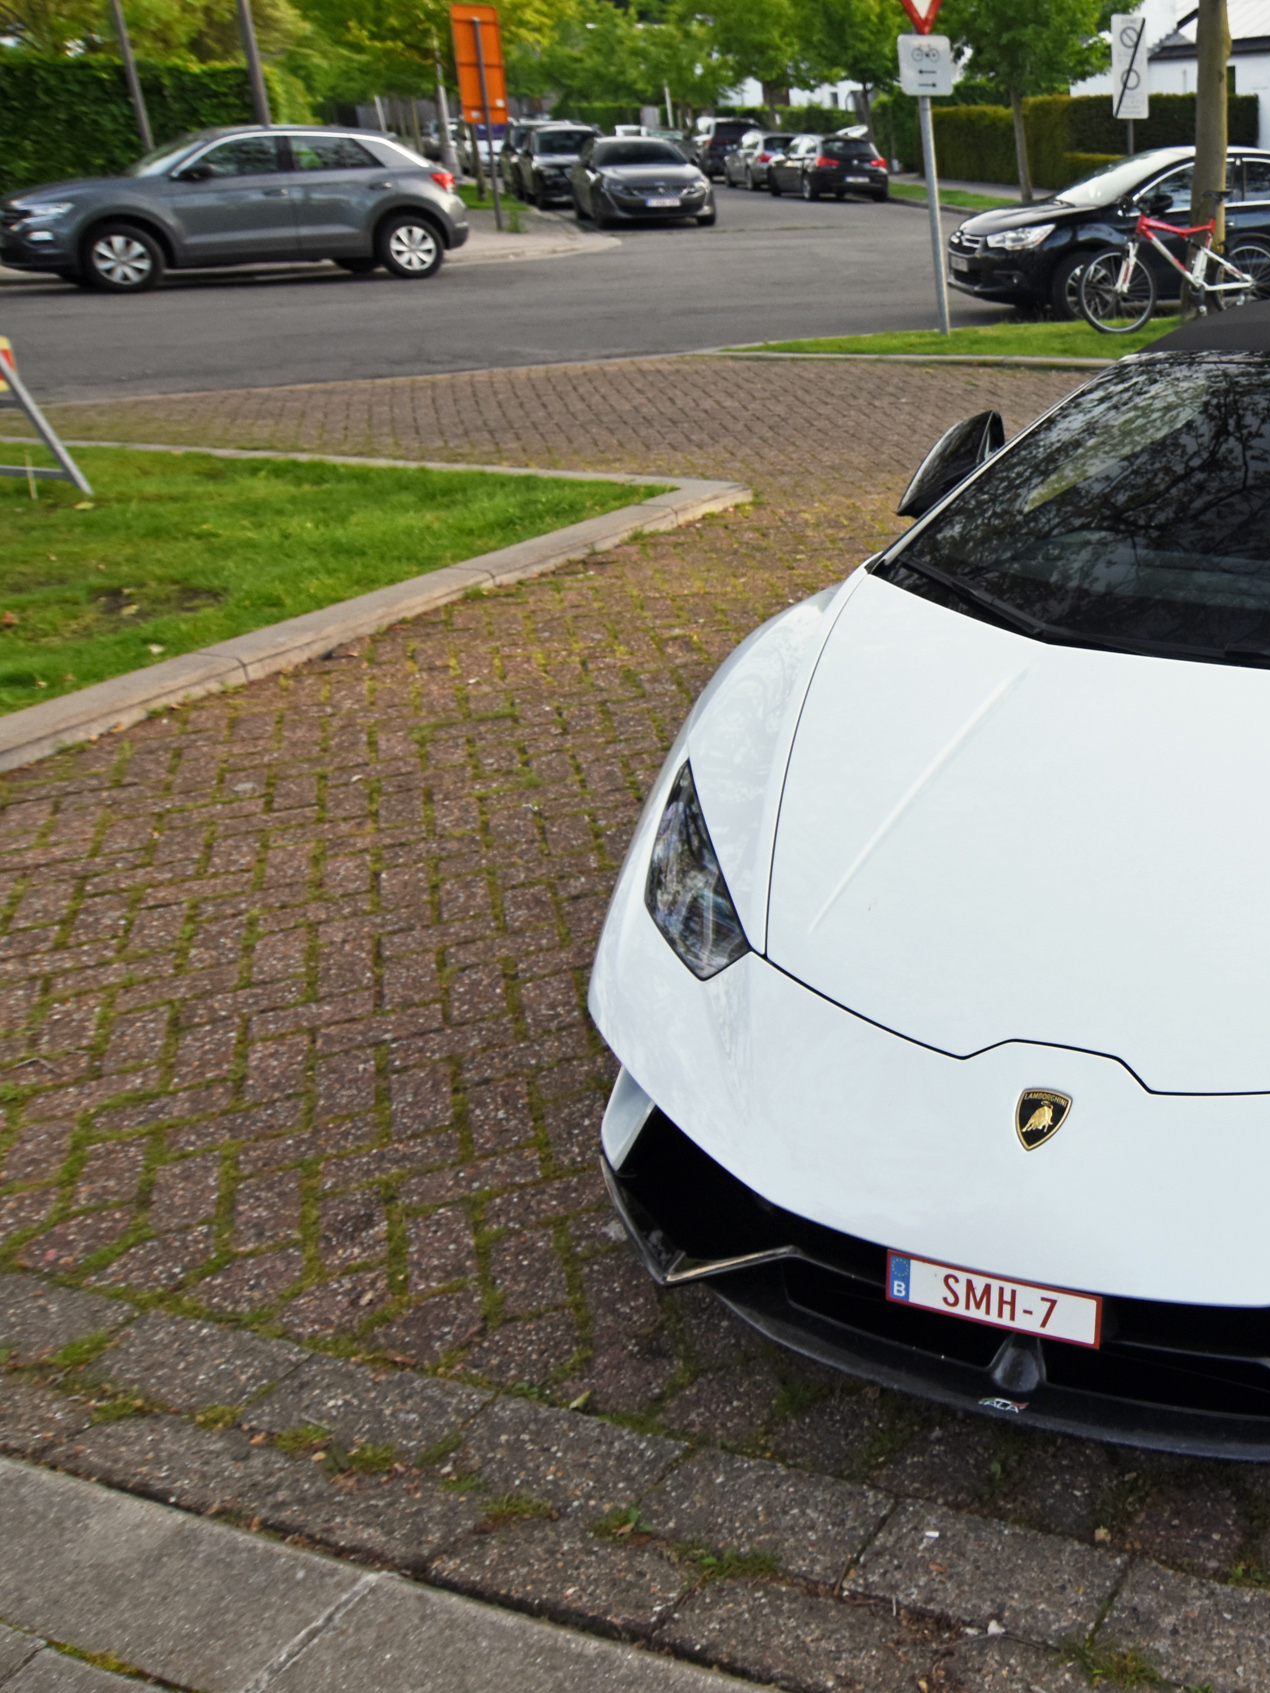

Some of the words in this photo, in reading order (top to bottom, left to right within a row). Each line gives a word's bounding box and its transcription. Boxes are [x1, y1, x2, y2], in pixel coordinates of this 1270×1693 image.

[1024, 1092, 1067, 1107] LAMBORGHINI
[893, 1281, 906, 1297] B
[942, 1274, 1057, 1329] SMH-7
